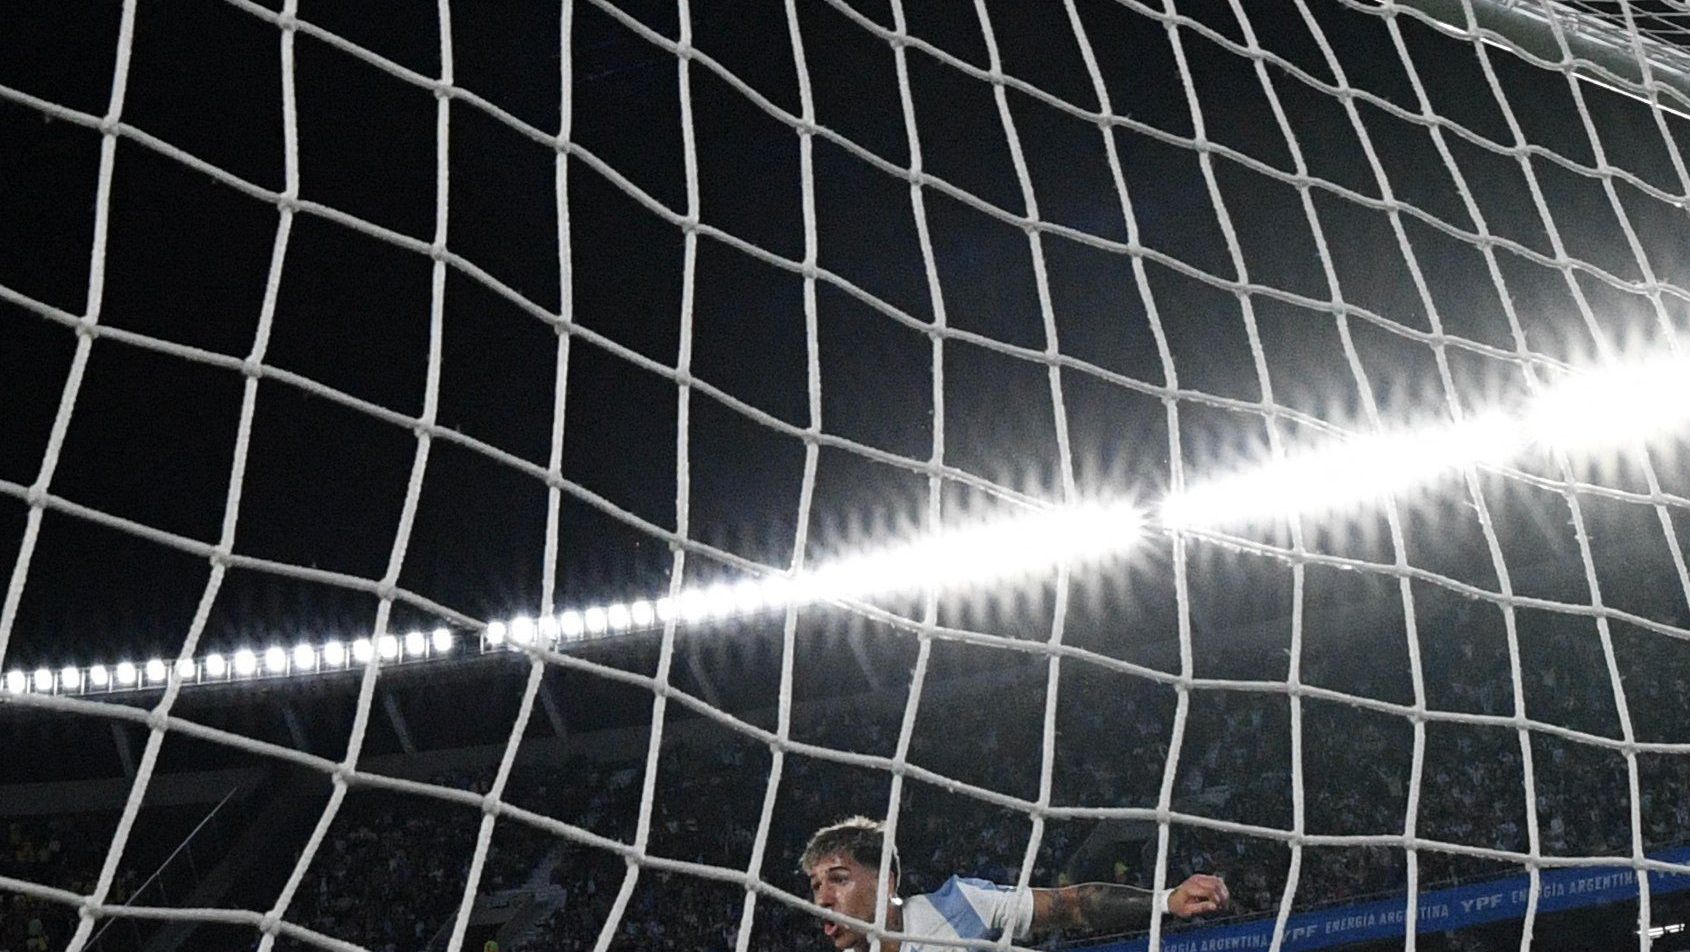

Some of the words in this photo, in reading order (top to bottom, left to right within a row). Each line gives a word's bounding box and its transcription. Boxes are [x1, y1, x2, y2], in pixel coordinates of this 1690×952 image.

[1201, 936, 1268, 951] ARGENTINA
[1379, 902, 1449, 925] ARGTINA
[1460, 893, 1504, 914] YPF
[1511, 880, 1565, 905] ENGÍA
